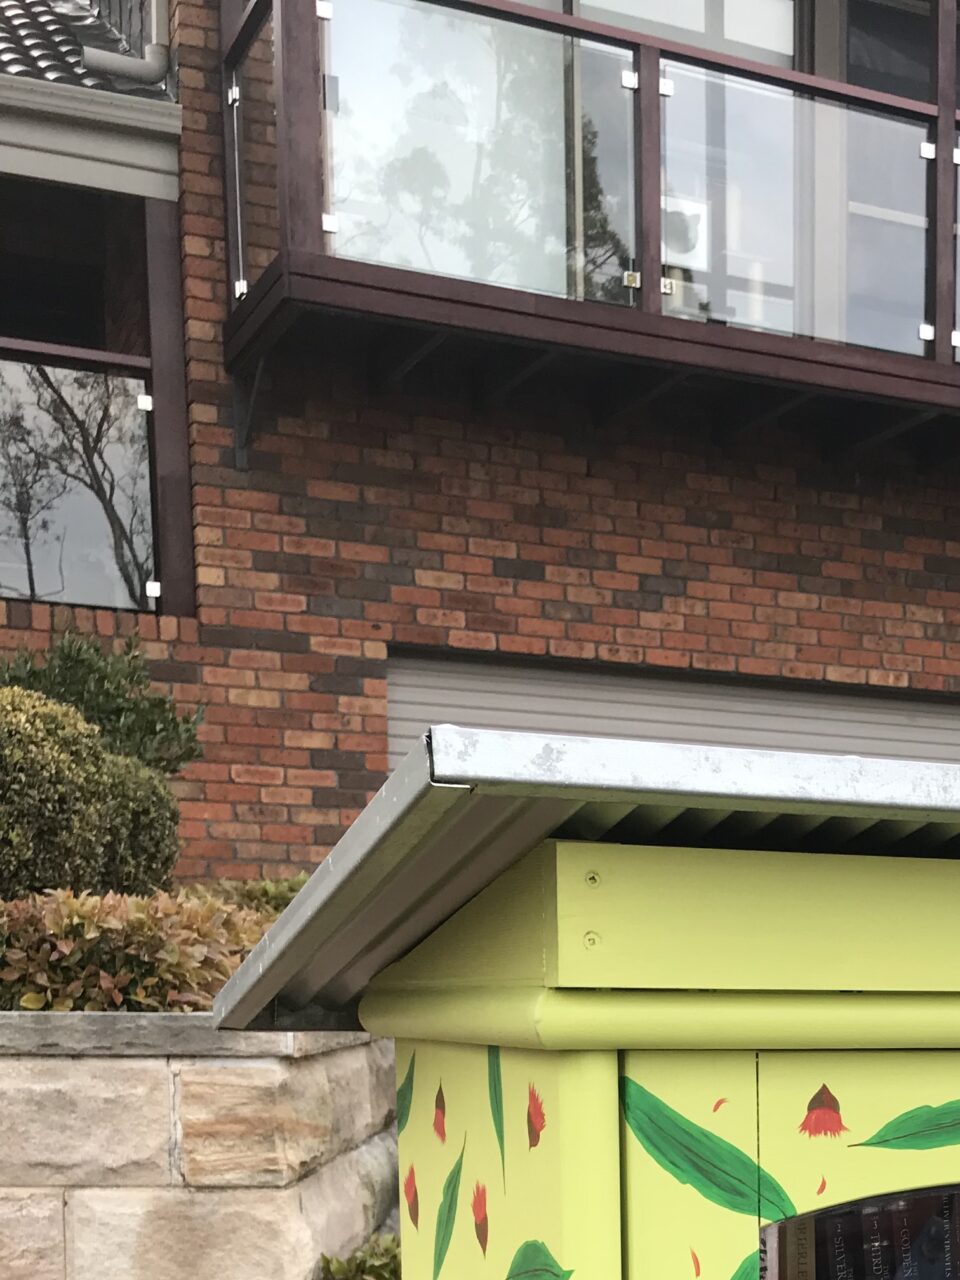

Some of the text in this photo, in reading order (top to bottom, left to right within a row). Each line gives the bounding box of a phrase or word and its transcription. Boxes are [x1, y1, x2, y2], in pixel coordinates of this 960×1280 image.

[834, 1237, 847, 1280] SILVER
[870, 1234, 882, 1275] THIRD
[900, 1229, 913, 1277] GOLDEN
